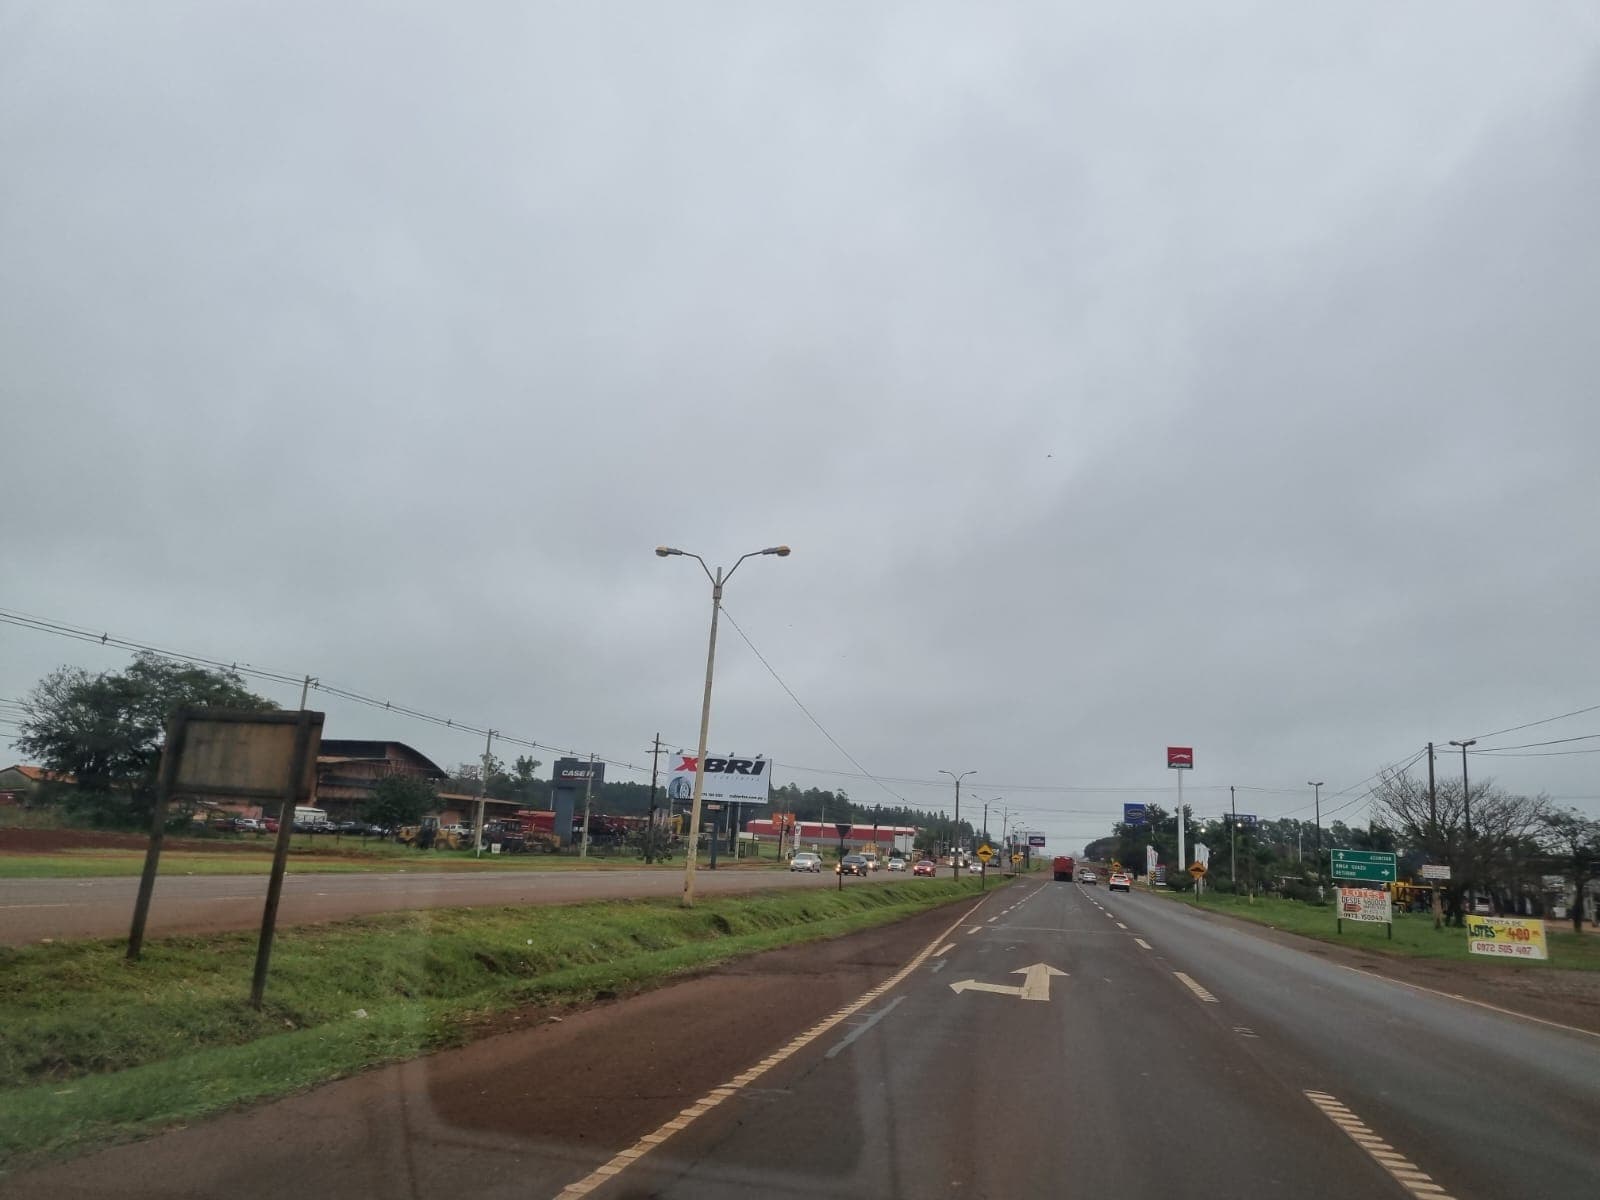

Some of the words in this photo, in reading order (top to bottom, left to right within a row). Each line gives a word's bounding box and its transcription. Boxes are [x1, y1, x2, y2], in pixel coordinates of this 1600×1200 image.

[561, 769, 586, 777] CASE
[674, 756, 766, 775] XBRI
[1468, 923, 1496, 938] LOTES
